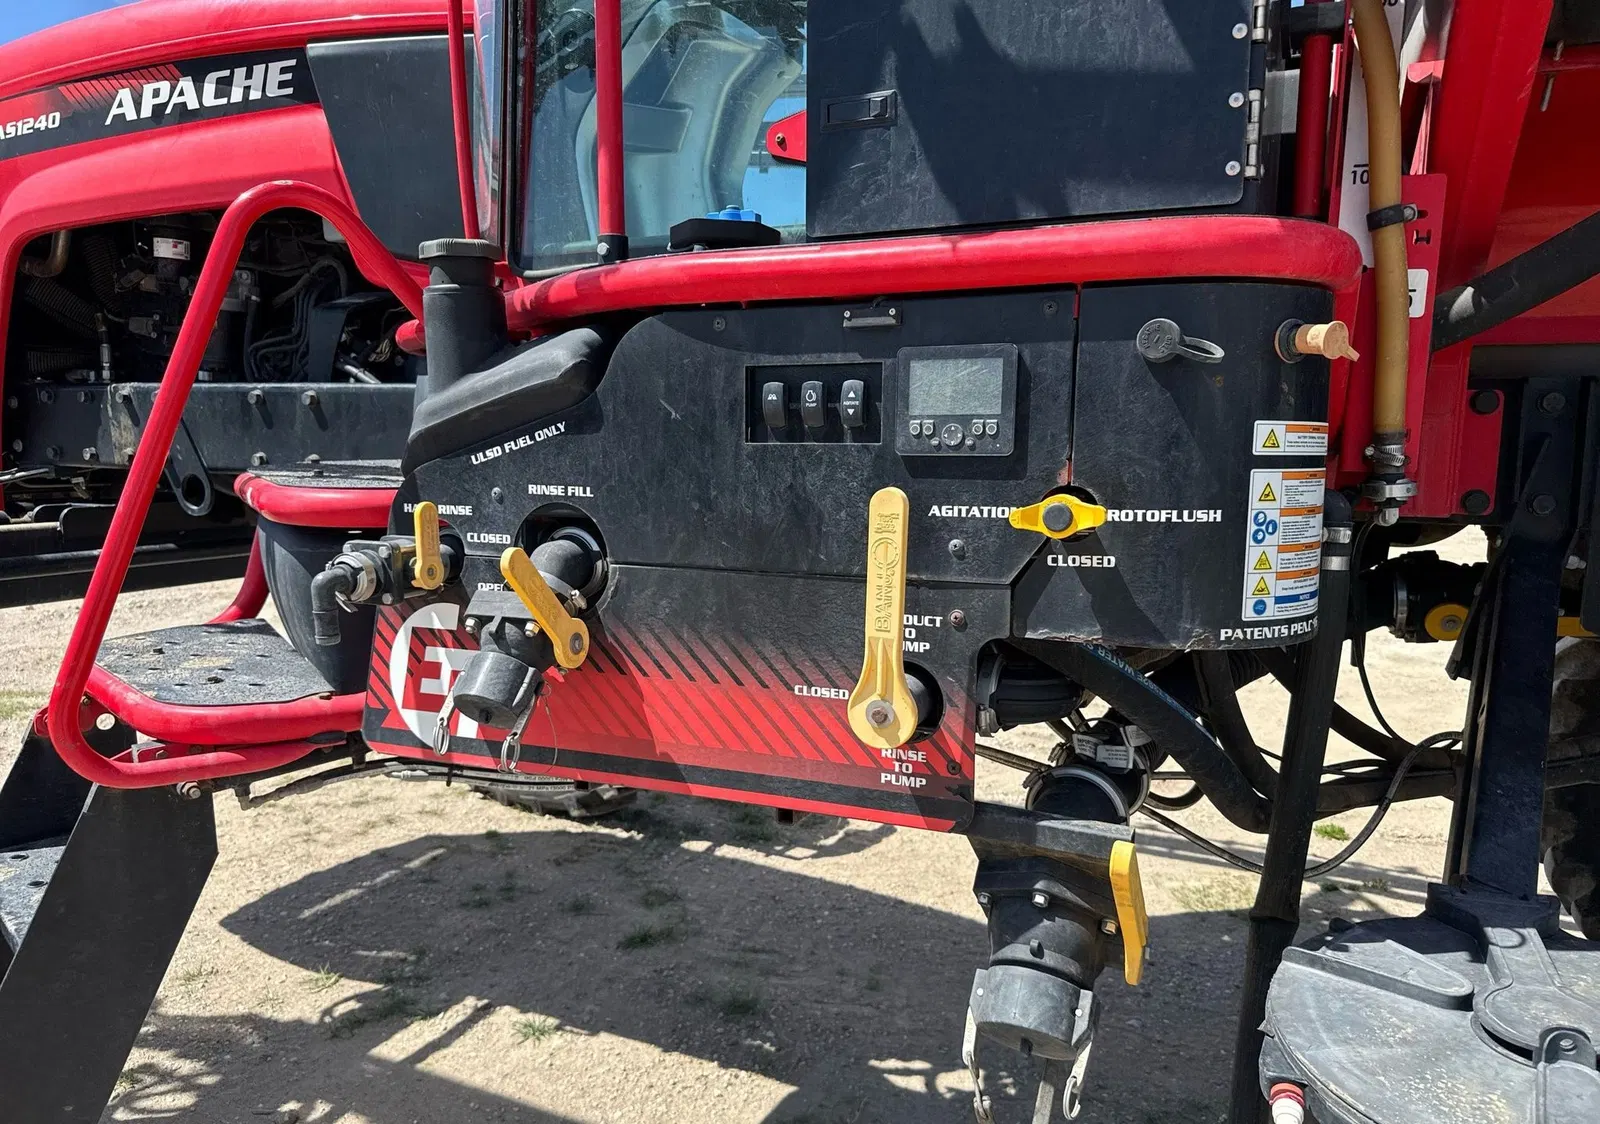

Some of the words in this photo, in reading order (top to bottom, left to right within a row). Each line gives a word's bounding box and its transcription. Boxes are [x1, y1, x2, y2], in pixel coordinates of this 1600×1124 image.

[105, 59, 297, 126] APACHE
[0, 111, 61, 140] AS1240
[470, 446, 502, 466] ULSD
[504, 436, 534, 454] FUEL
[535, 421, 567, 441] ONLY
[528, 485, 566, 497] RINSE
[567, 486, 594, 498] FILL
[438, 504, 473, 516] RINSE
[1107, 508, 1222, 523] ROTOFLUSH
[467, 532, 511, 544] CLOSED
[1047, 554, 1116, 568] CLOSED
[904, 614, 943, 628] DUCT
[902, 627, 916, 639] O
[1220, 625, 1289, 641] PATENTS
[1097, 646, 1136, 677] WATER
[794, 684, 849, 700] CLOSED
[881, 748, 927, 763] RINSE
[892, 761, 913, 774] TO
[880, 774, 927, 789] PUMP
